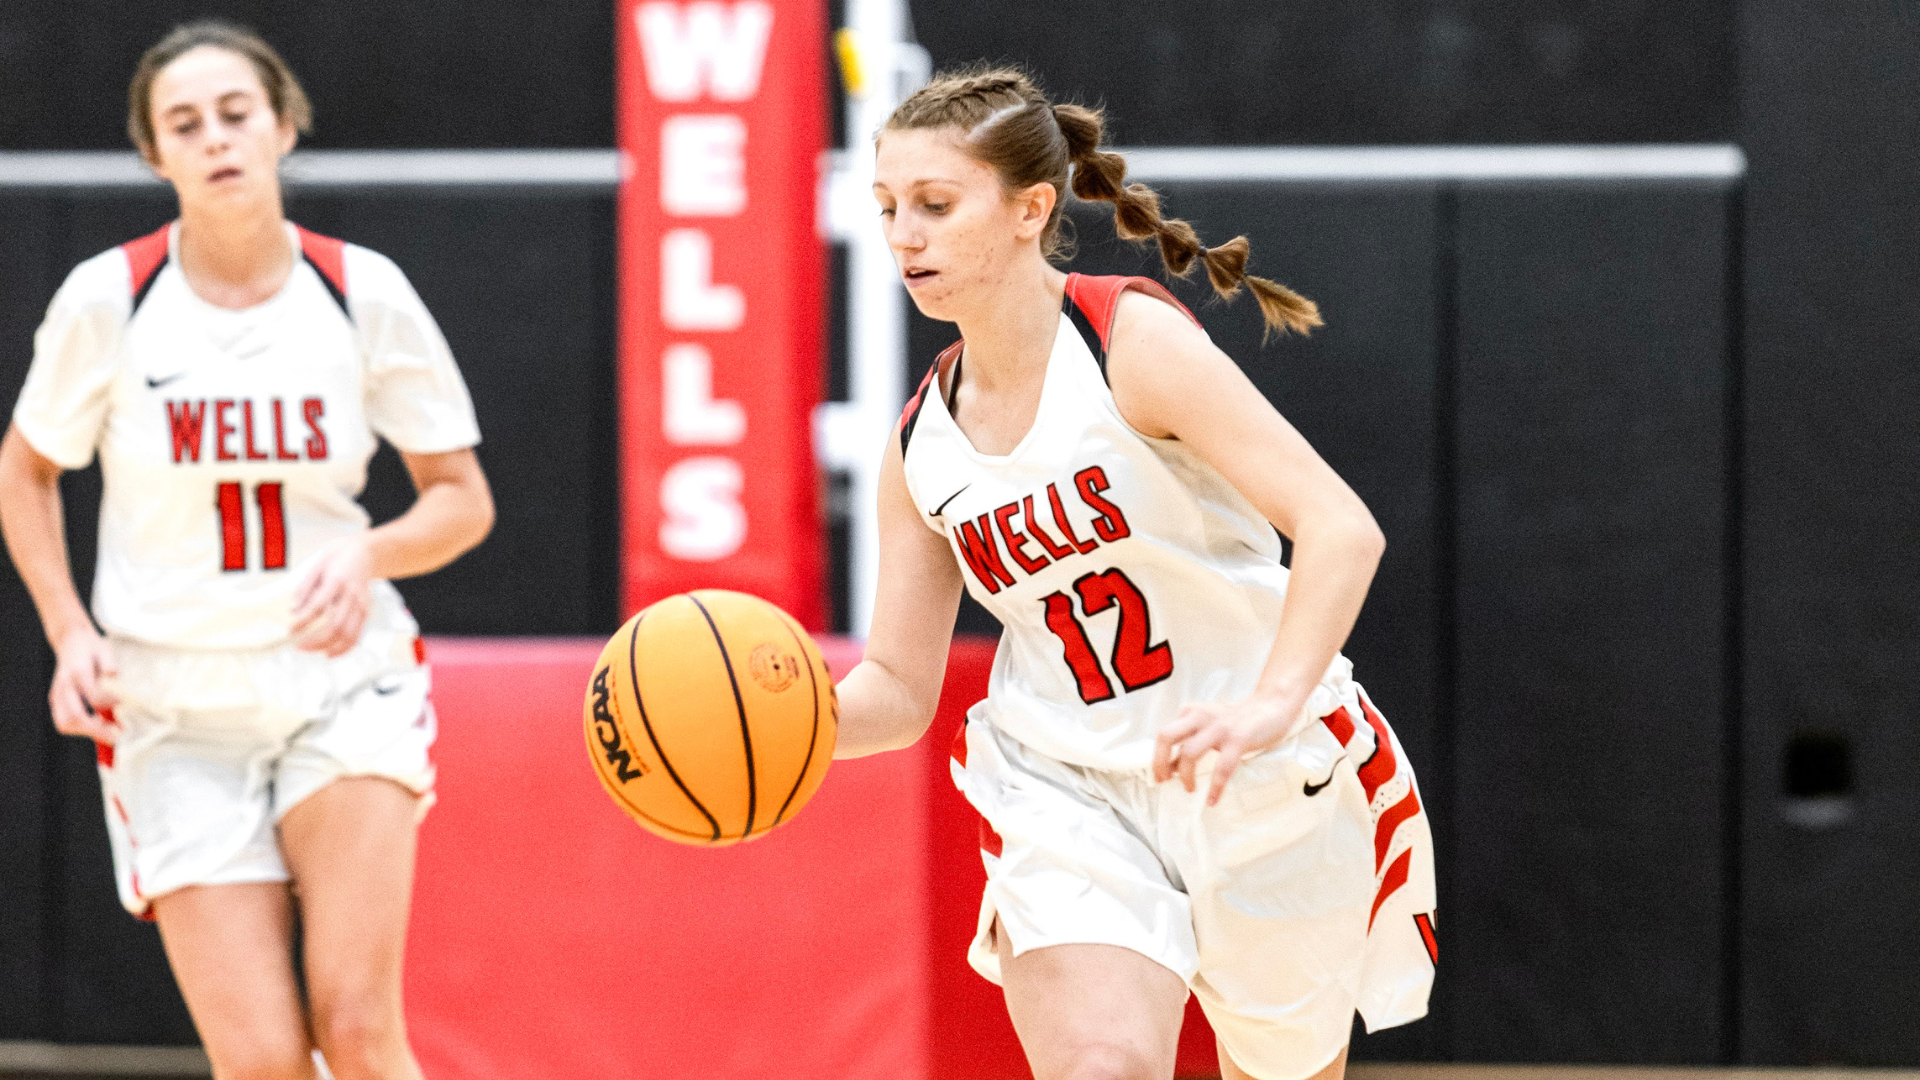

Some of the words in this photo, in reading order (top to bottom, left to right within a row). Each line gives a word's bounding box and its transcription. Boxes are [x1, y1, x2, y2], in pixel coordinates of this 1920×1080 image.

[635, 2, 774, 562] WELLS
[165, 397, 328, 463] WELLS
[214, 481, 287, 570] 11
[953, 465, 1131, 595] WELLS
[1038, 567, 1174, 706] 12
[592, 664, 642, 784] NCAA
